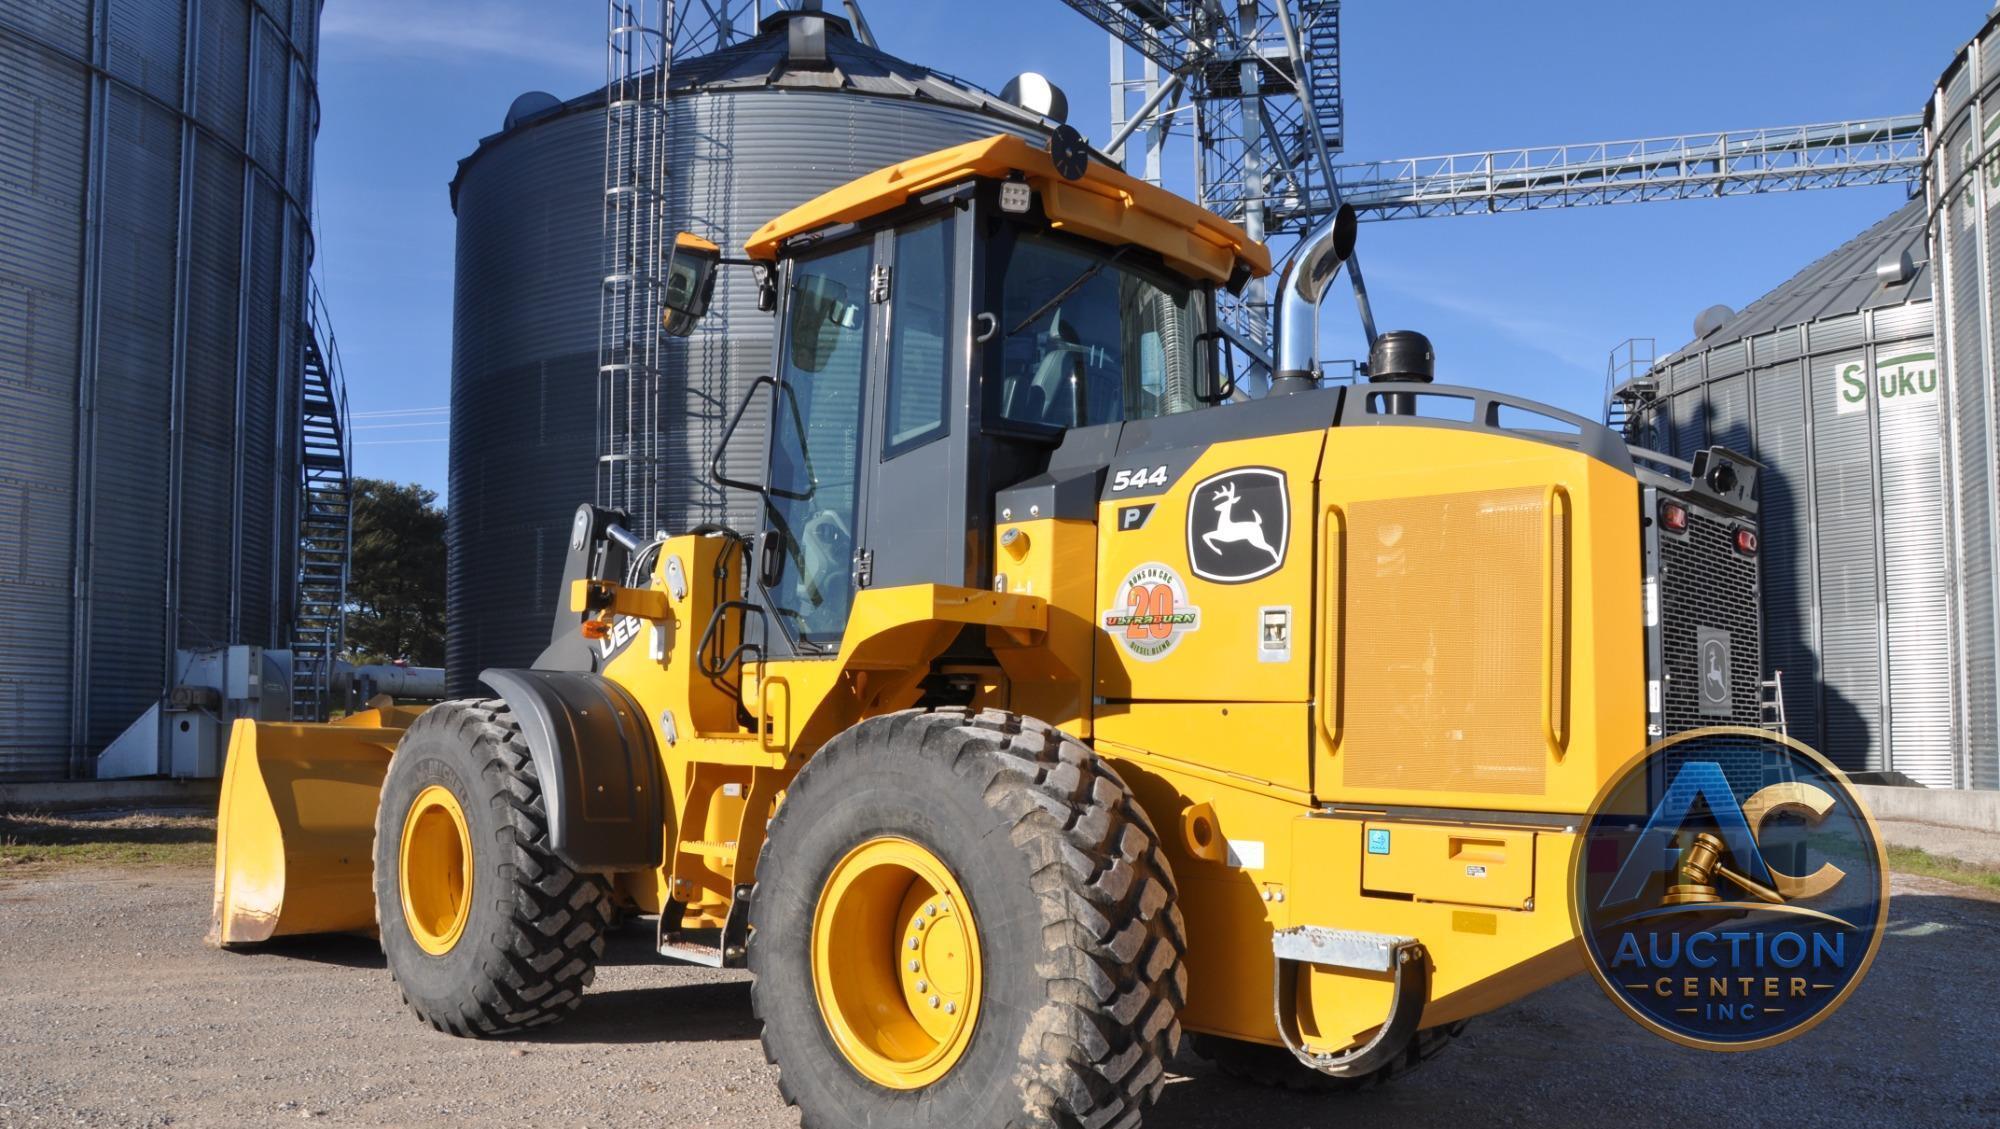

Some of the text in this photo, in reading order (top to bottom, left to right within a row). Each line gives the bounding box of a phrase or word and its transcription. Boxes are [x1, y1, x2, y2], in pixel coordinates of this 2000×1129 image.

[1112, 465, 1168, 491] 544
[1124, 509, 1140, 528] P
[1128, 572, 1146, 588] RUNS
[1148, 568, 1157, 577] ON
[1127, 584, 1174, 639] 20
